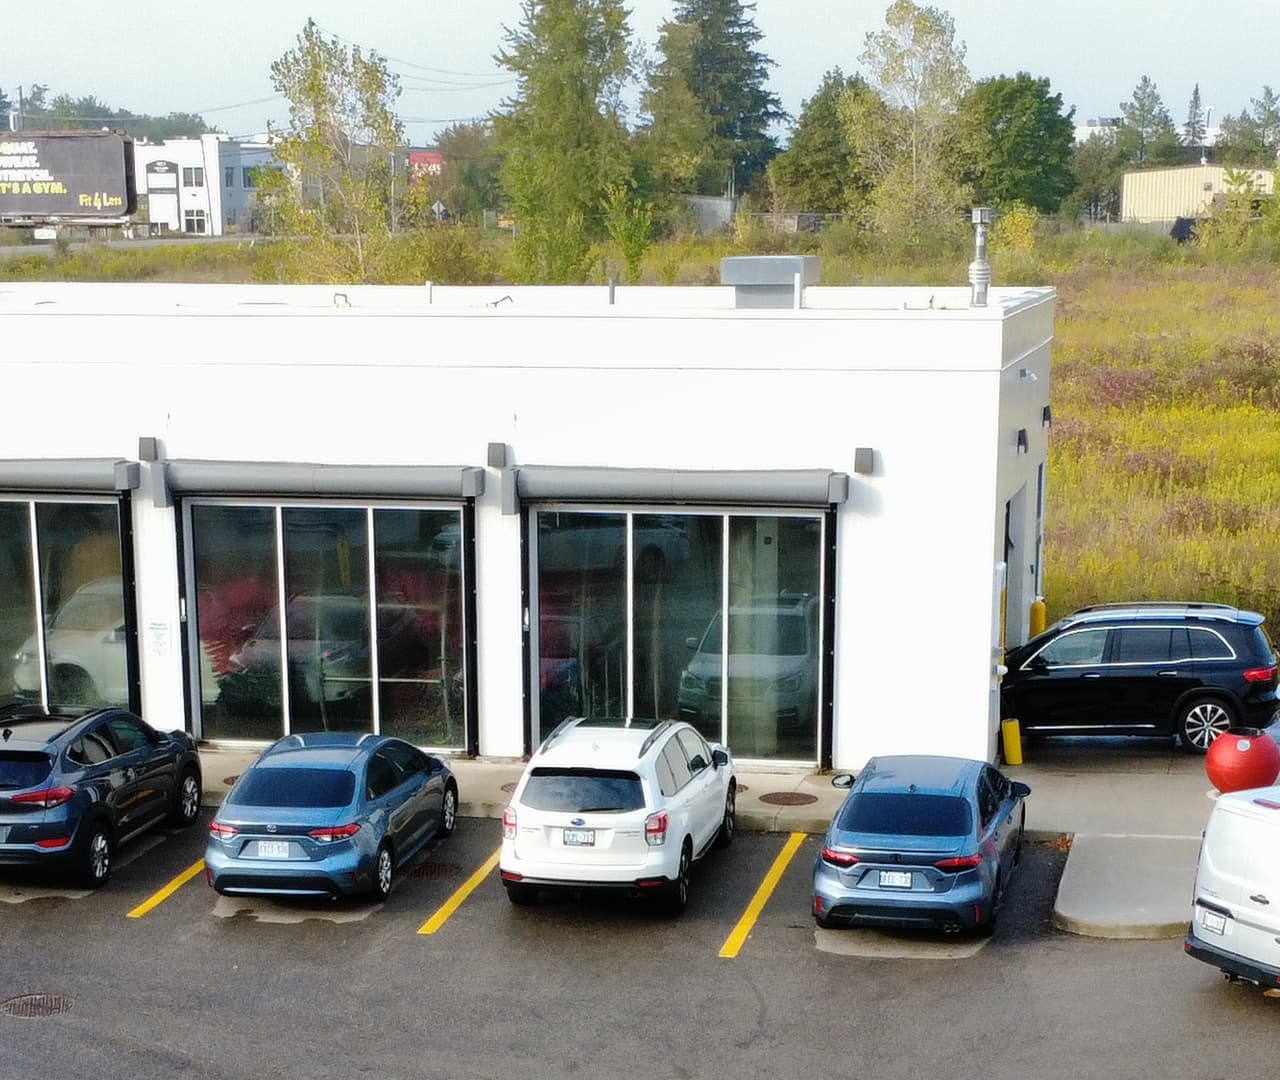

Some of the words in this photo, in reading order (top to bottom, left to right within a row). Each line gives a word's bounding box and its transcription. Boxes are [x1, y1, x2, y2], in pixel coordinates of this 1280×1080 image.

[22, 183, 32, 194] A
[33, 182, 68, 194] GYM.
[78, 193, 92, 207] Fit
[93, 191, 102, 210] 4
